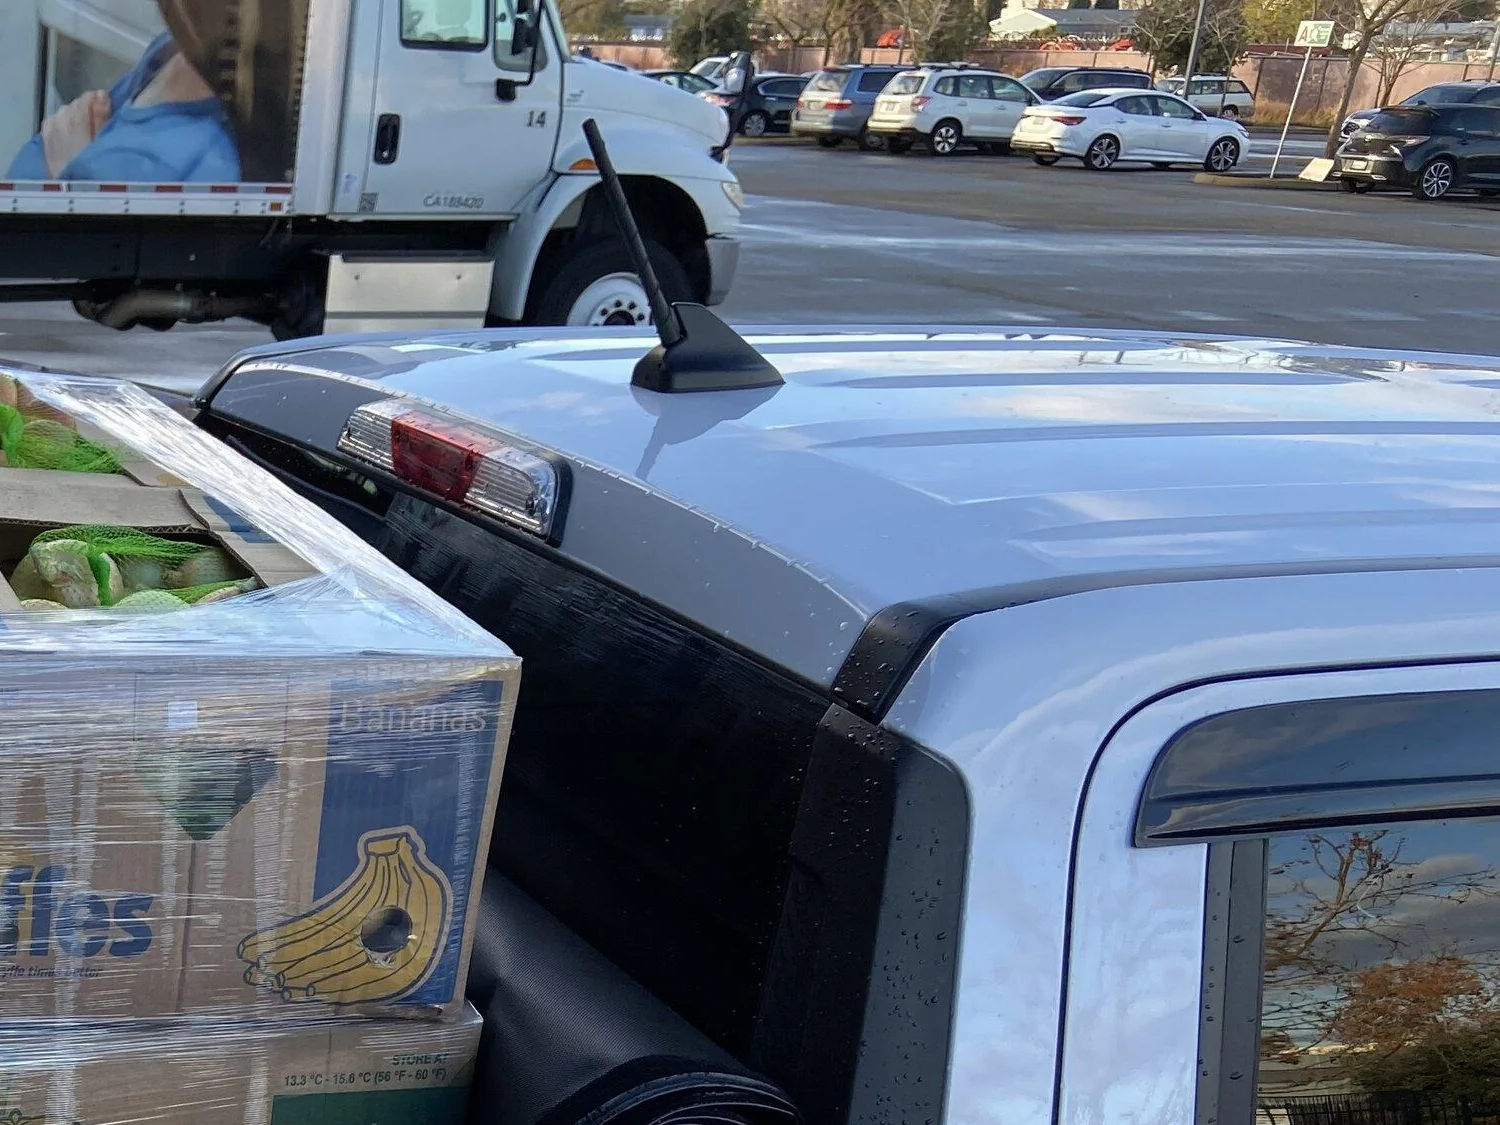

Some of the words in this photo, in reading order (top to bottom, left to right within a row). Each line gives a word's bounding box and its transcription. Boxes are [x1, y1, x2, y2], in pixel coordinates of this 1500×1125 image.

[527, 110, 547, 127] 14
[341, 700, 488, 732] Bananas
[284, 1074, 307, 1087] 13.3
[310, 1073, 323, 1085] °C
[334, 1071, 355, 1085] 15.6
[358, 1071, 372, 1084] °C
[374, 1069, 391, 1085] (56
[394, 1069, 407, 1082] °F
[415, 1068, 429, 1081] 60
[431, 1067, 447, 1082] °F)
